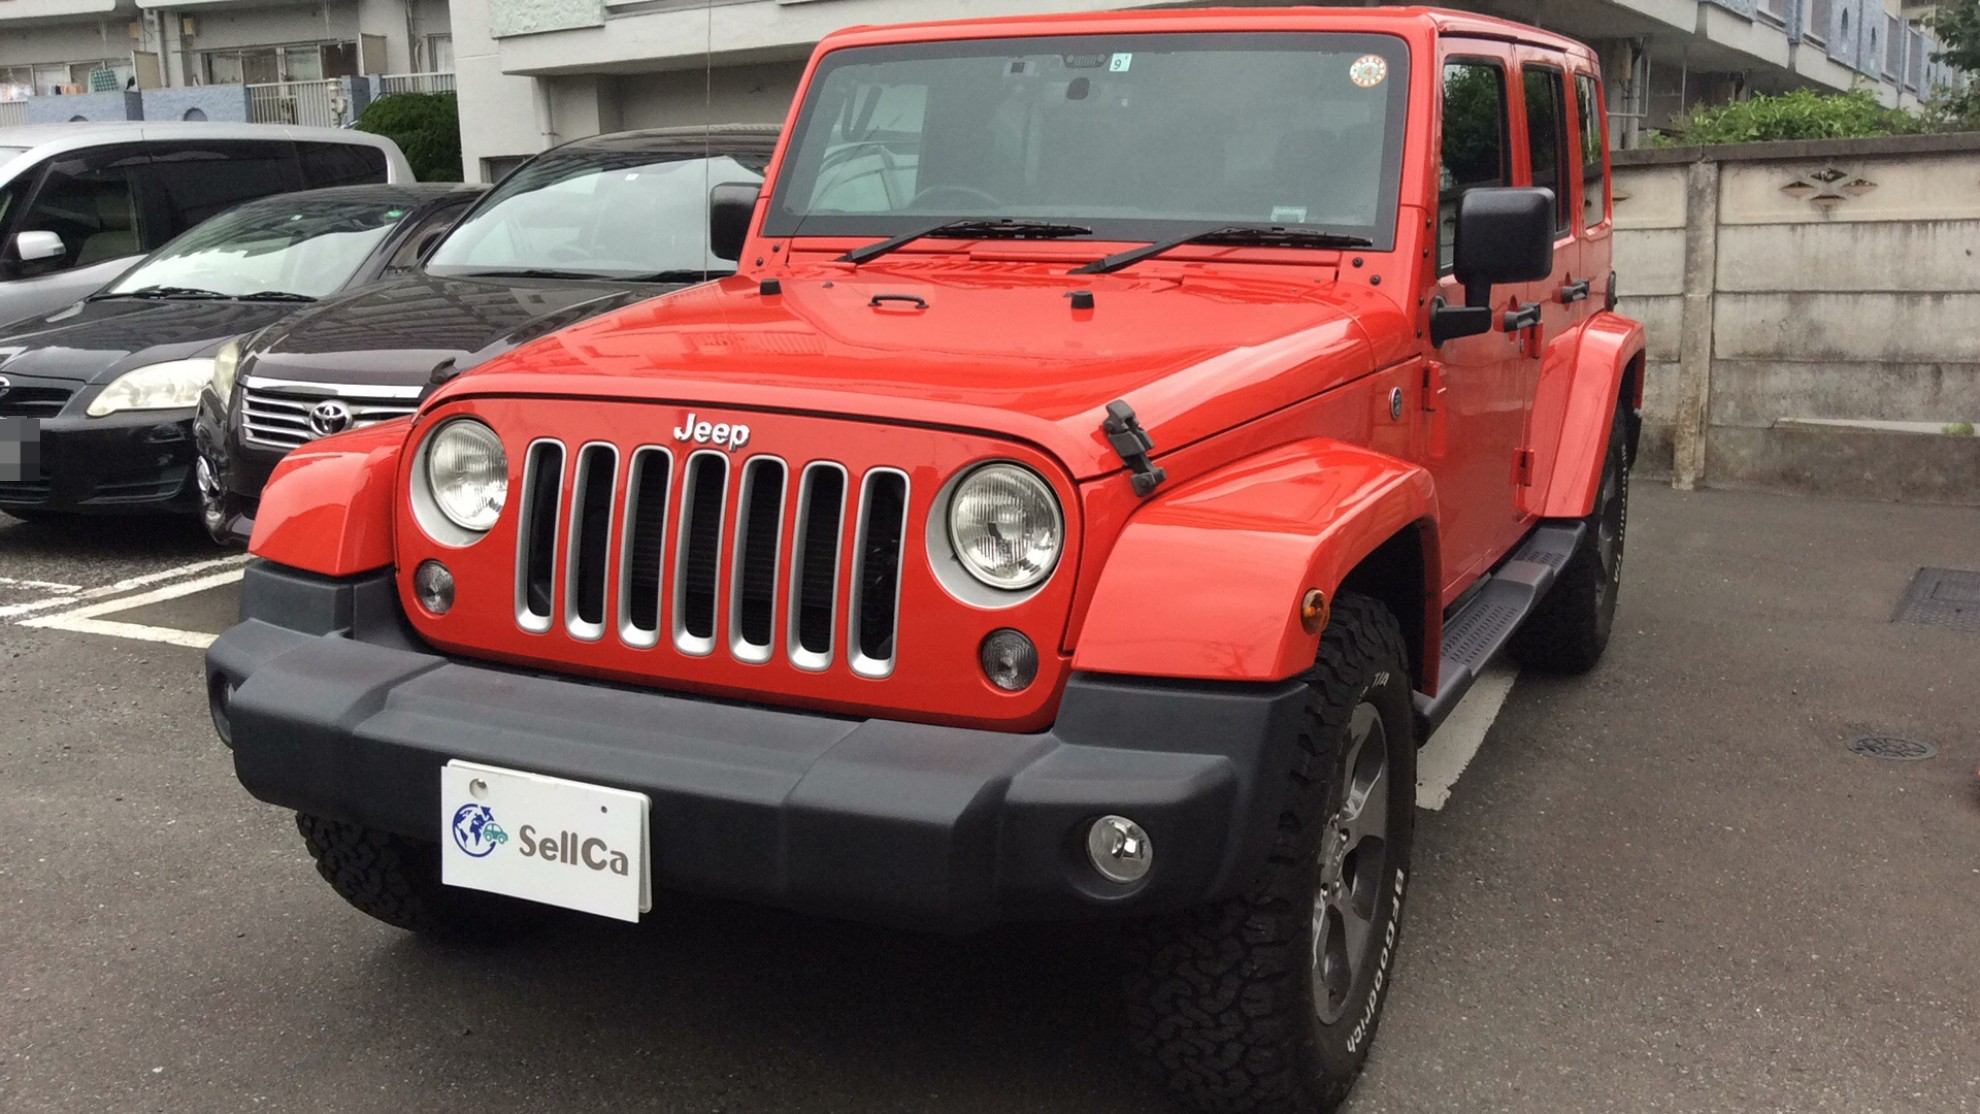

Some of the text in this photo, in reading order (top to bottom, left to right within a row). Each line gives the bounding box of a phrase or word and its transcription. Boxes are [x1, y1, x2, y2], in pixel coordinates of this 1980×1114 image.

[1114, 59, 1122, 70] 9
[673, 413, 751, 452] Jeep
[519, 824, 629, 876] SellCa
[1347, 868, 1404, 1053] BFGoodrich
